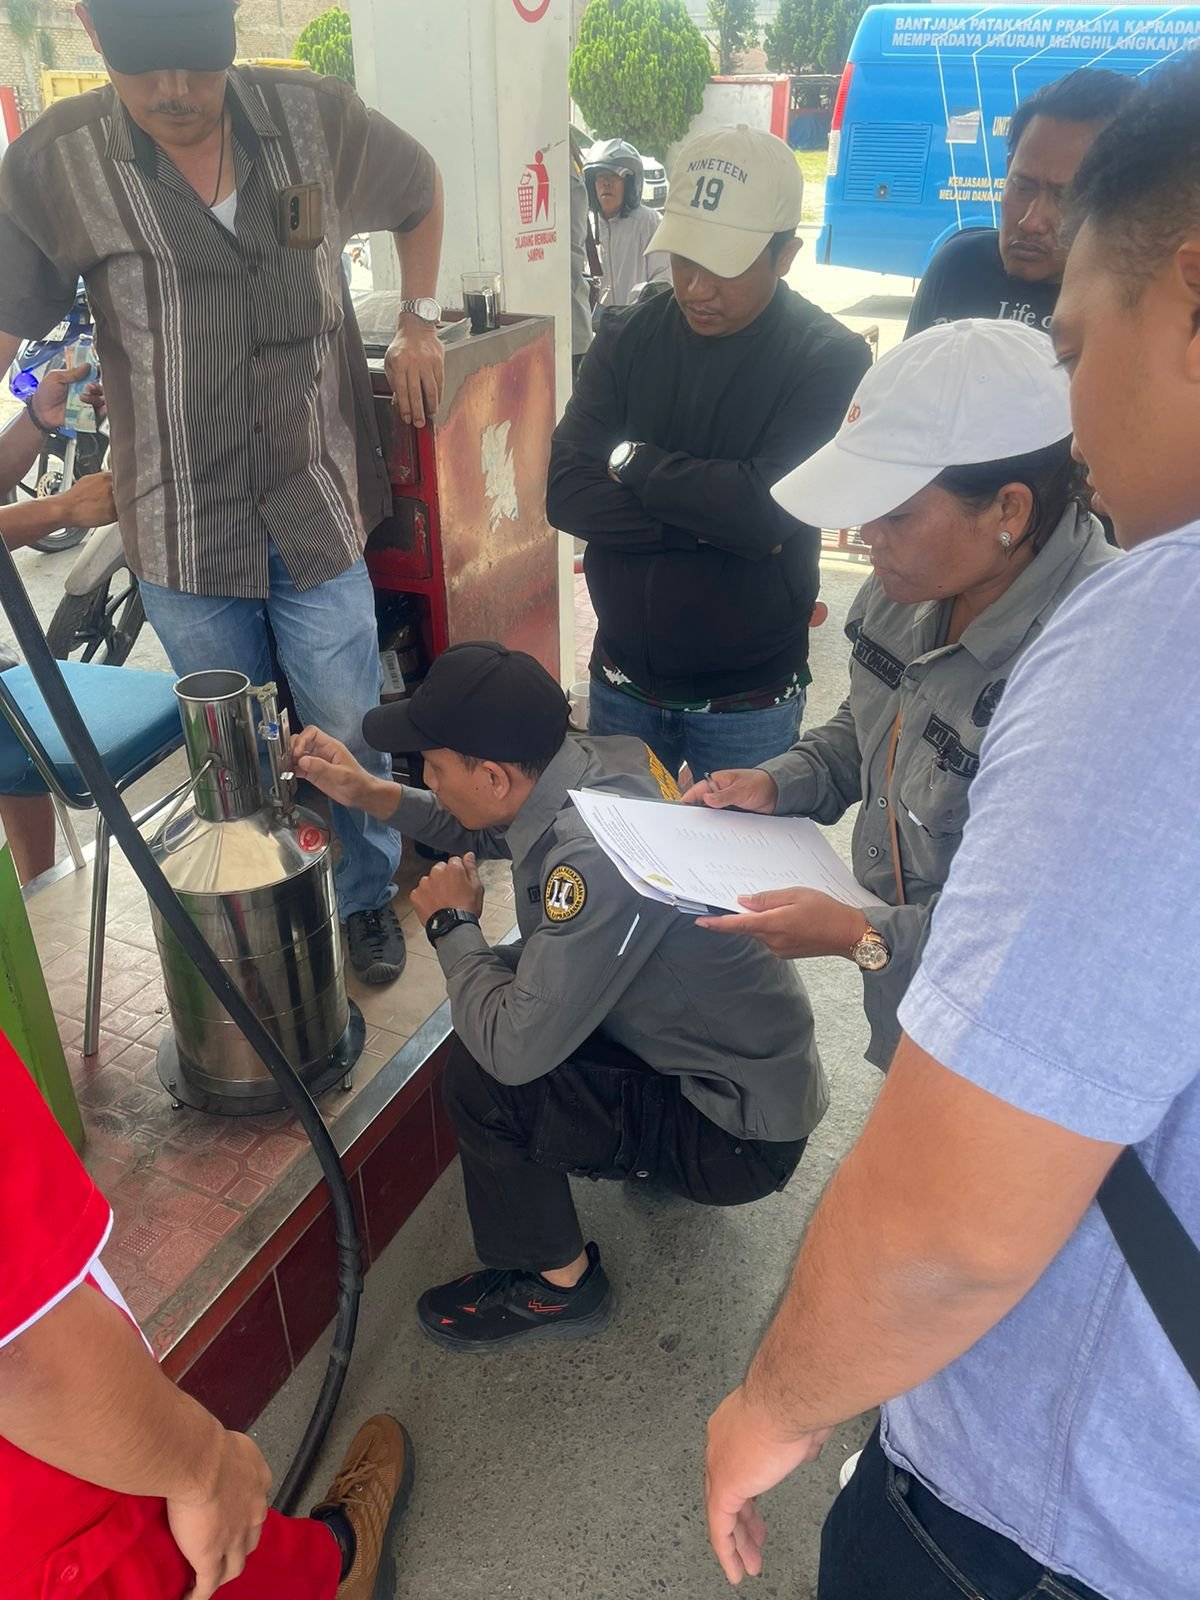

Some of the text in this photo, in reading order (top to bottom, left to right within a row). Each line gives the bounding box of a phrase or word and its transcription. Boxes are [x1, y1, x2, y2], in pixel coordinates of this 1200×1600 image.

[895, 17, 966, 31] BANTJANA
[970, 18, 1052, 33] PATAKARAN
[1055, 19, 1119, 33] PRALAYA
[892, 33, 982, 47] MEMPERDAYA
[987, 34, 1046, 48] UKURAN
[1050, 35, 1178, 51] MENGHILANGKAN
[686, 158, 748, 184] NINETEEN
[690, 175, 724, 212] 19
[998, 301, 1036, 326] Life
